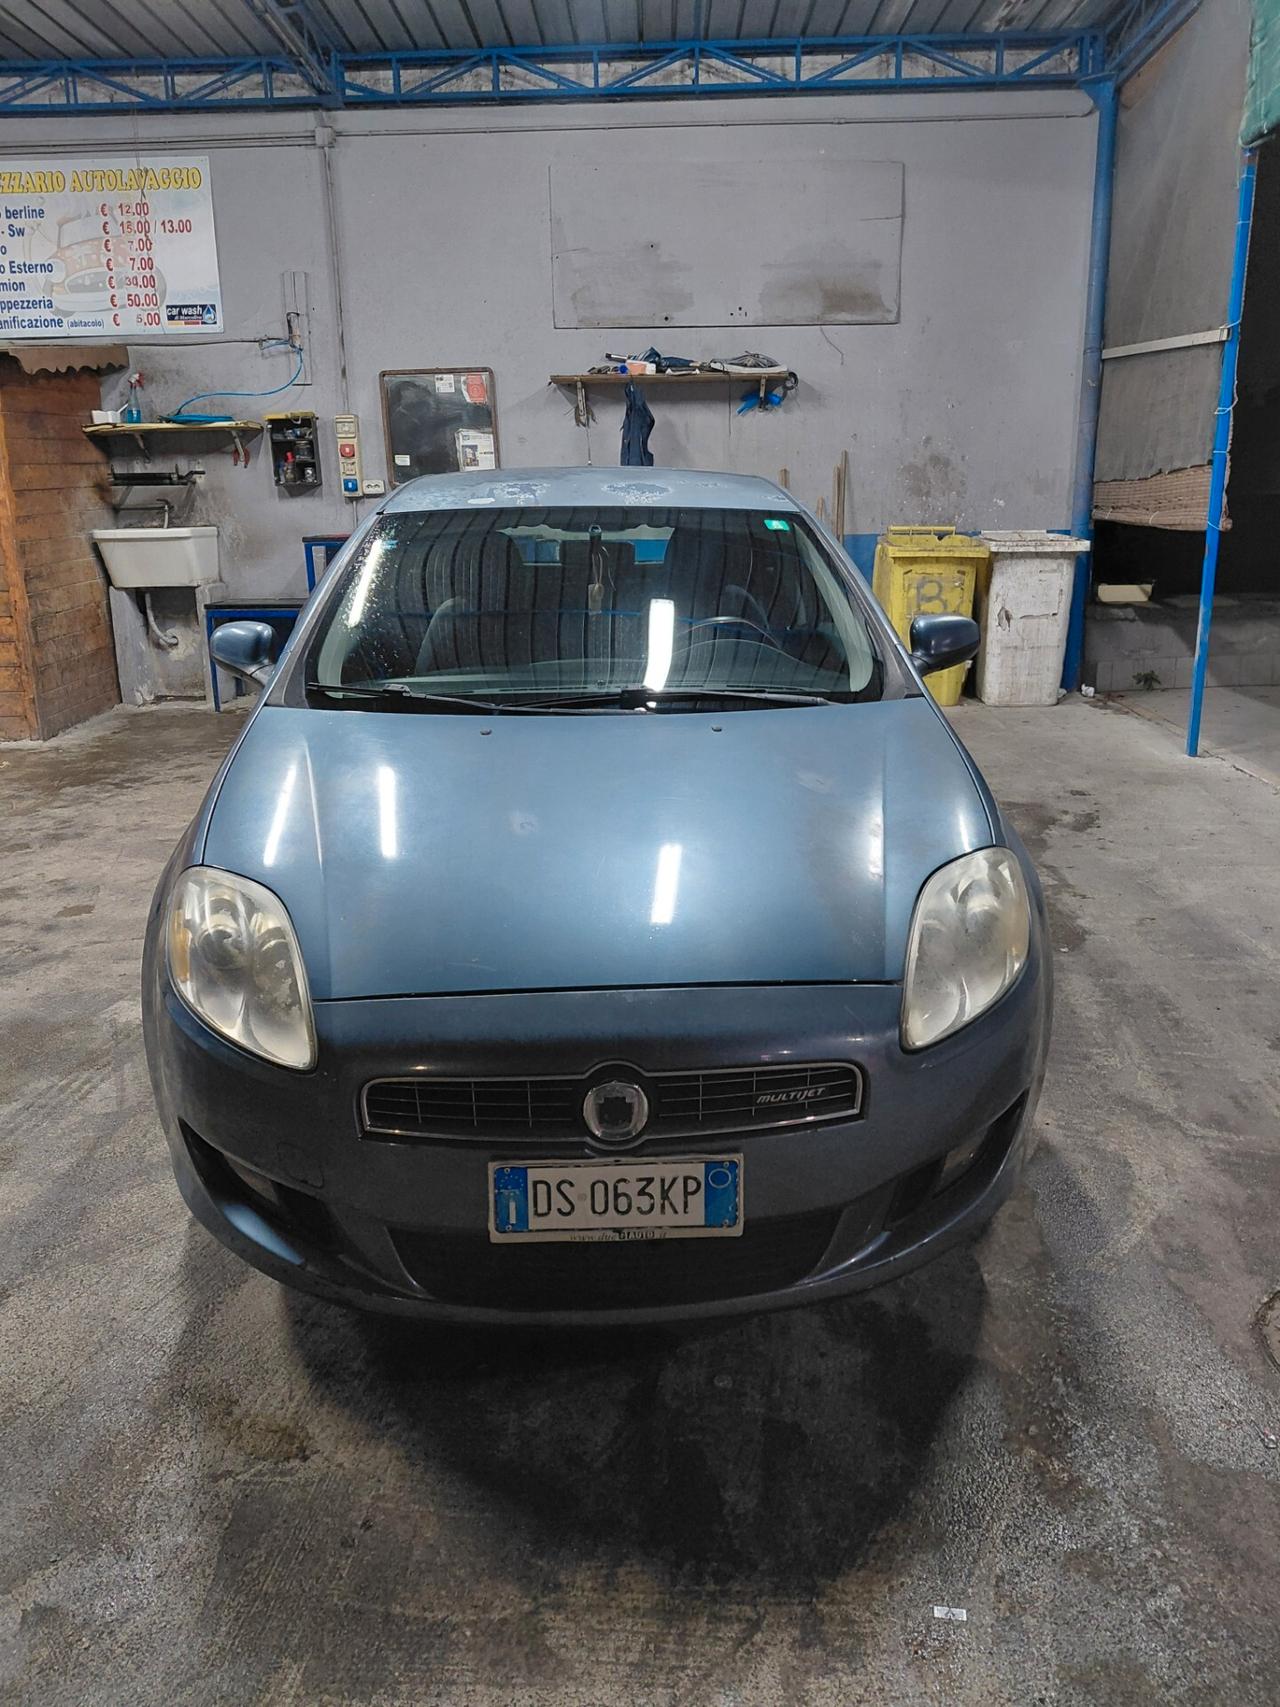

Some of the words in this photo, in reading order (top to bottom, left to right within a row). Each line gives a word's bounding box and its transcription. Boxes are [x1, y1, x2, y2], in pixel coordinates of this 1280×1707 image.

[0, 171, 65, 194] ZZARIO
[70, 167, 202, 192] AUTOLAVAGGIO
[5, 206, 45, 220] berline
[100, 203, 108, 217] €
[118, 202, 149, 216] 12.00
[8, 224, 26, 237] Sw
[102, 221, 110, 235] €
[161, 219, 192, 233] 13.00
[104, 239, 112, 252] €
[9, 260, 54, 274] Esterno
[106, 258, 113, 271] €
[129, 257, 154, 271] 7.00
[108, 276, 115, 289] €
[110, 294, 118, 307] €
[127, 293, 159, 307] 50.00
[167, 307, 179, 316] car
[181, 305, 202, 315] wash
[67, 319, 104, 329] (abitacolo)
[113, 313, 121, 327] €
[532, 1178, 575, 1218] DS
[590, 1174, 702, 1217] 063KP
